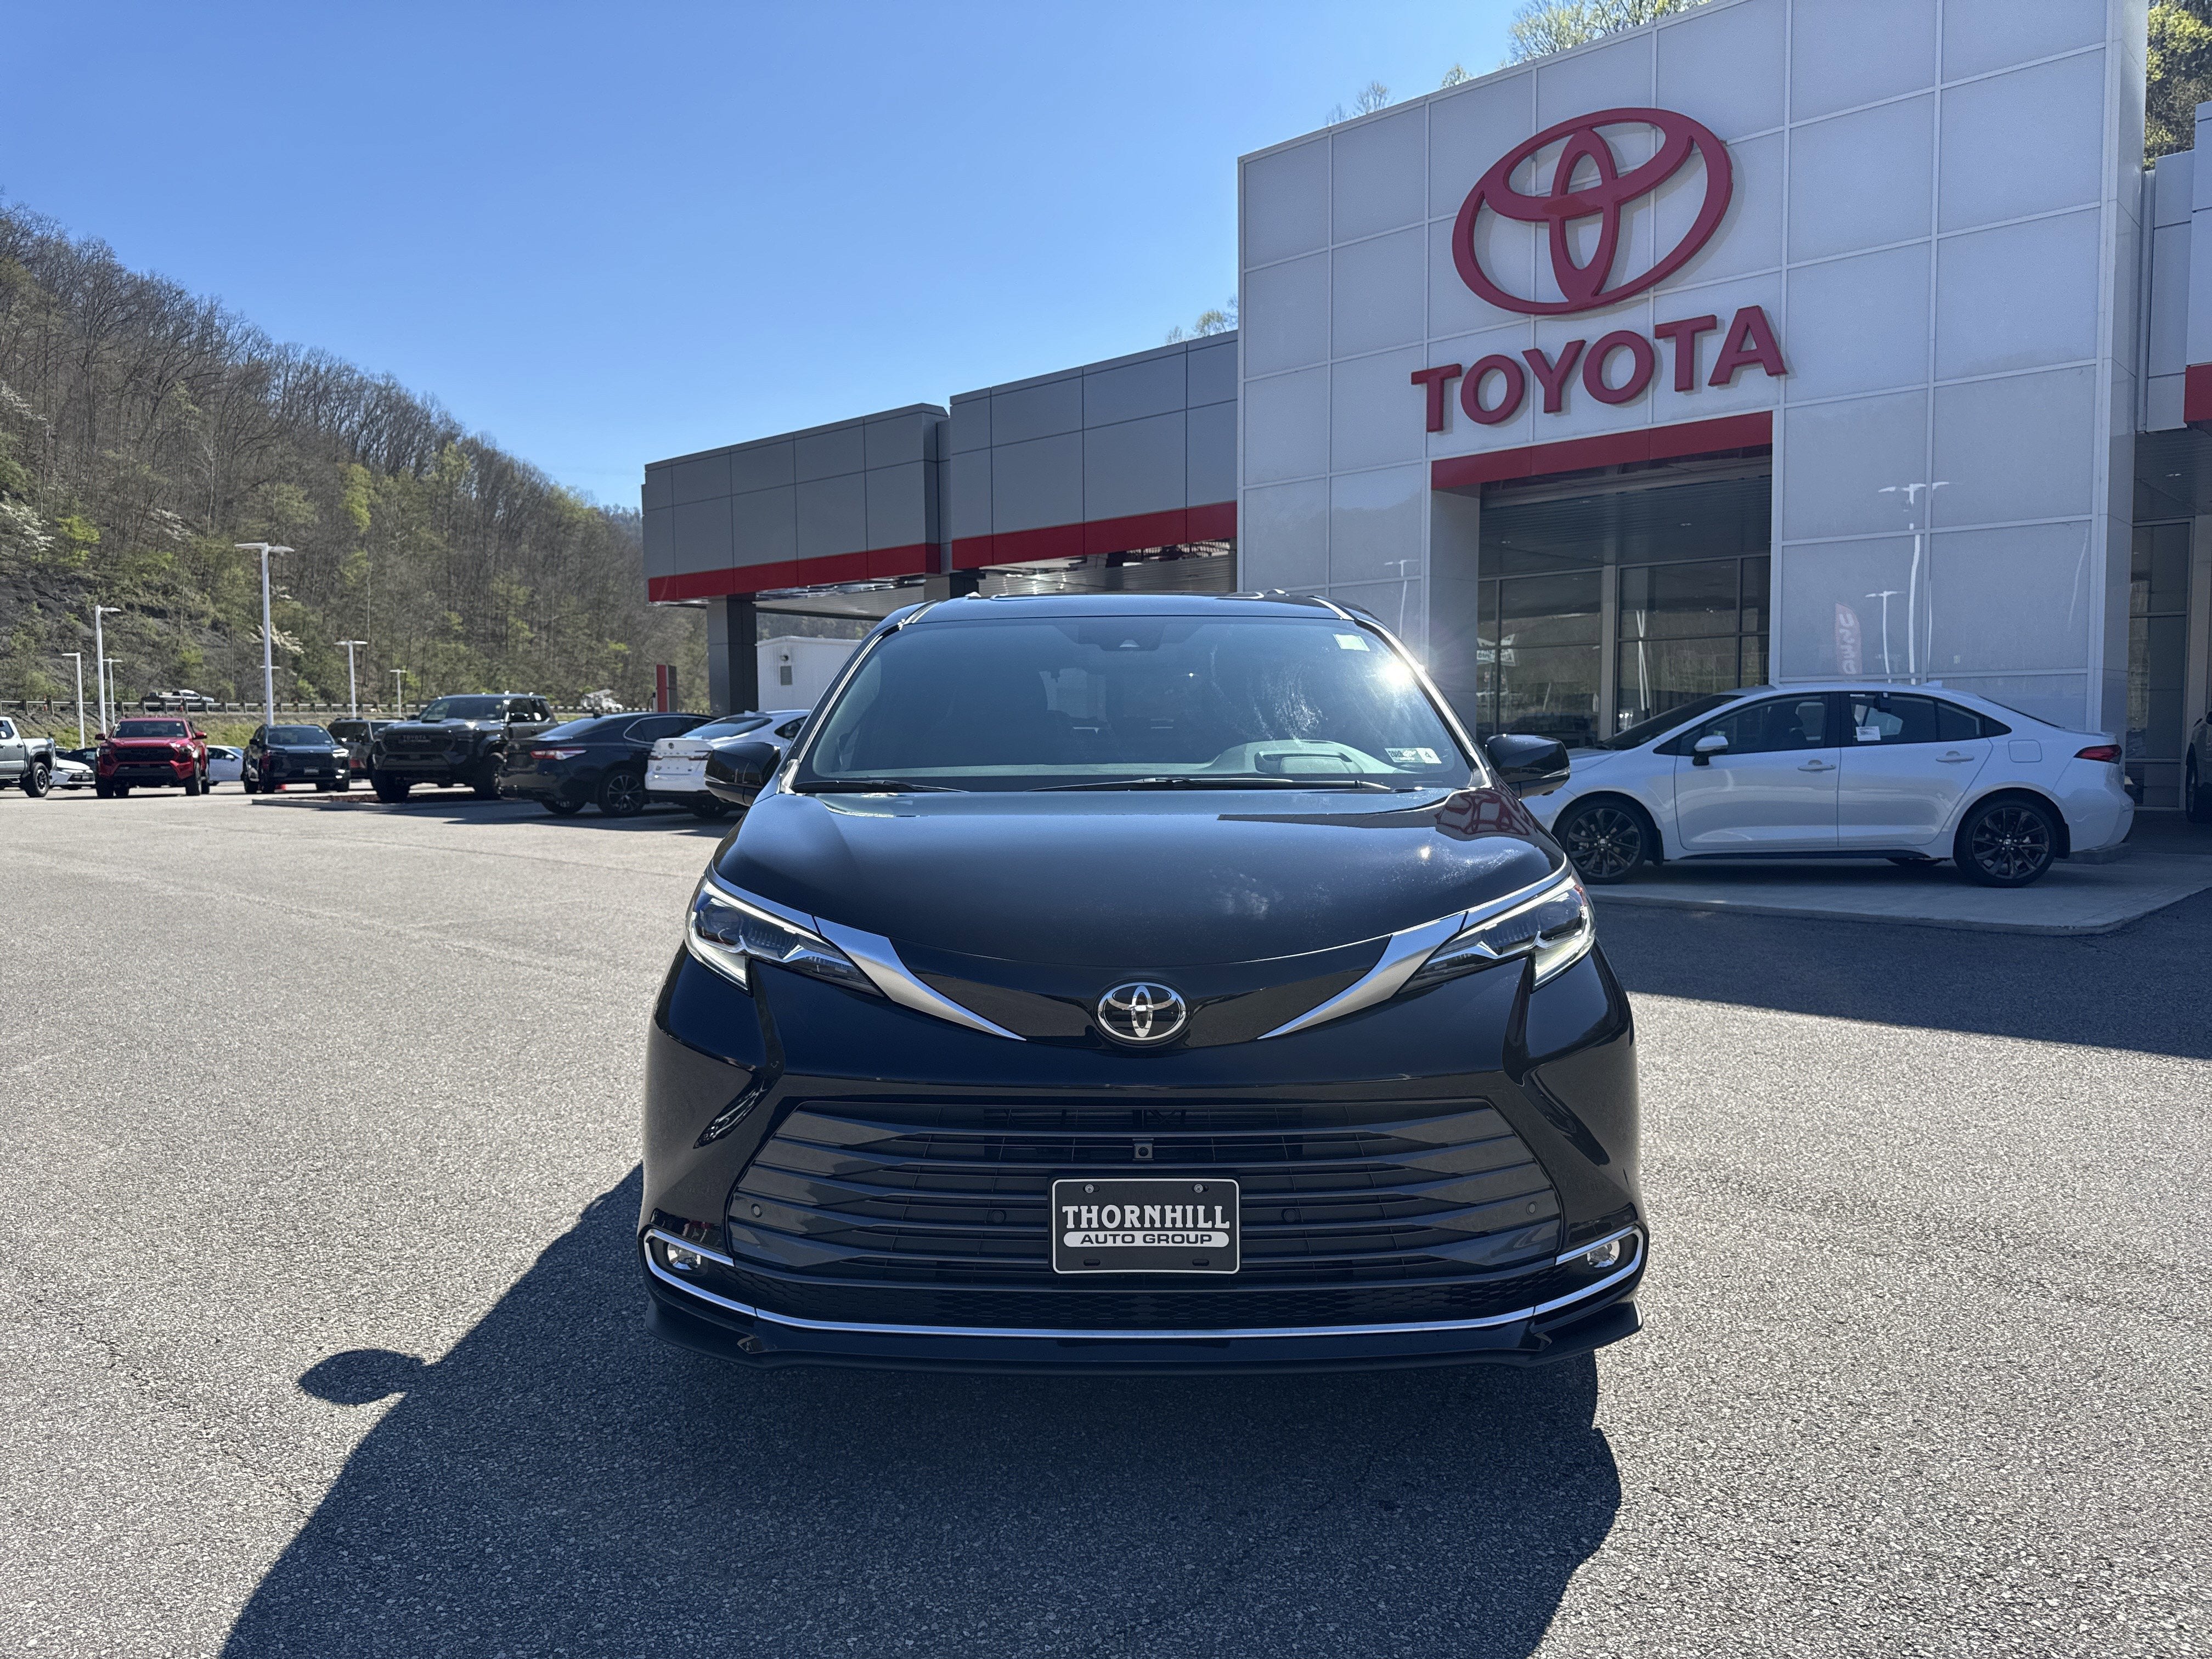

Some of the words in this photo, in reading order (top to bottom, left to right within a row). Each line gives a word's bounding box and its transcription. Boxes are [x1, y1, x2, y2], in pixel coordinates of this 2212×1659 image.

[1411, 305, 1788, 432] TOYOTA
[1062, 1205, 1230, 1229] THORNHILL
[1080, 1234, 1135, 1244] AUTO
[1143, 1234, 1212, 1244] GROUP
